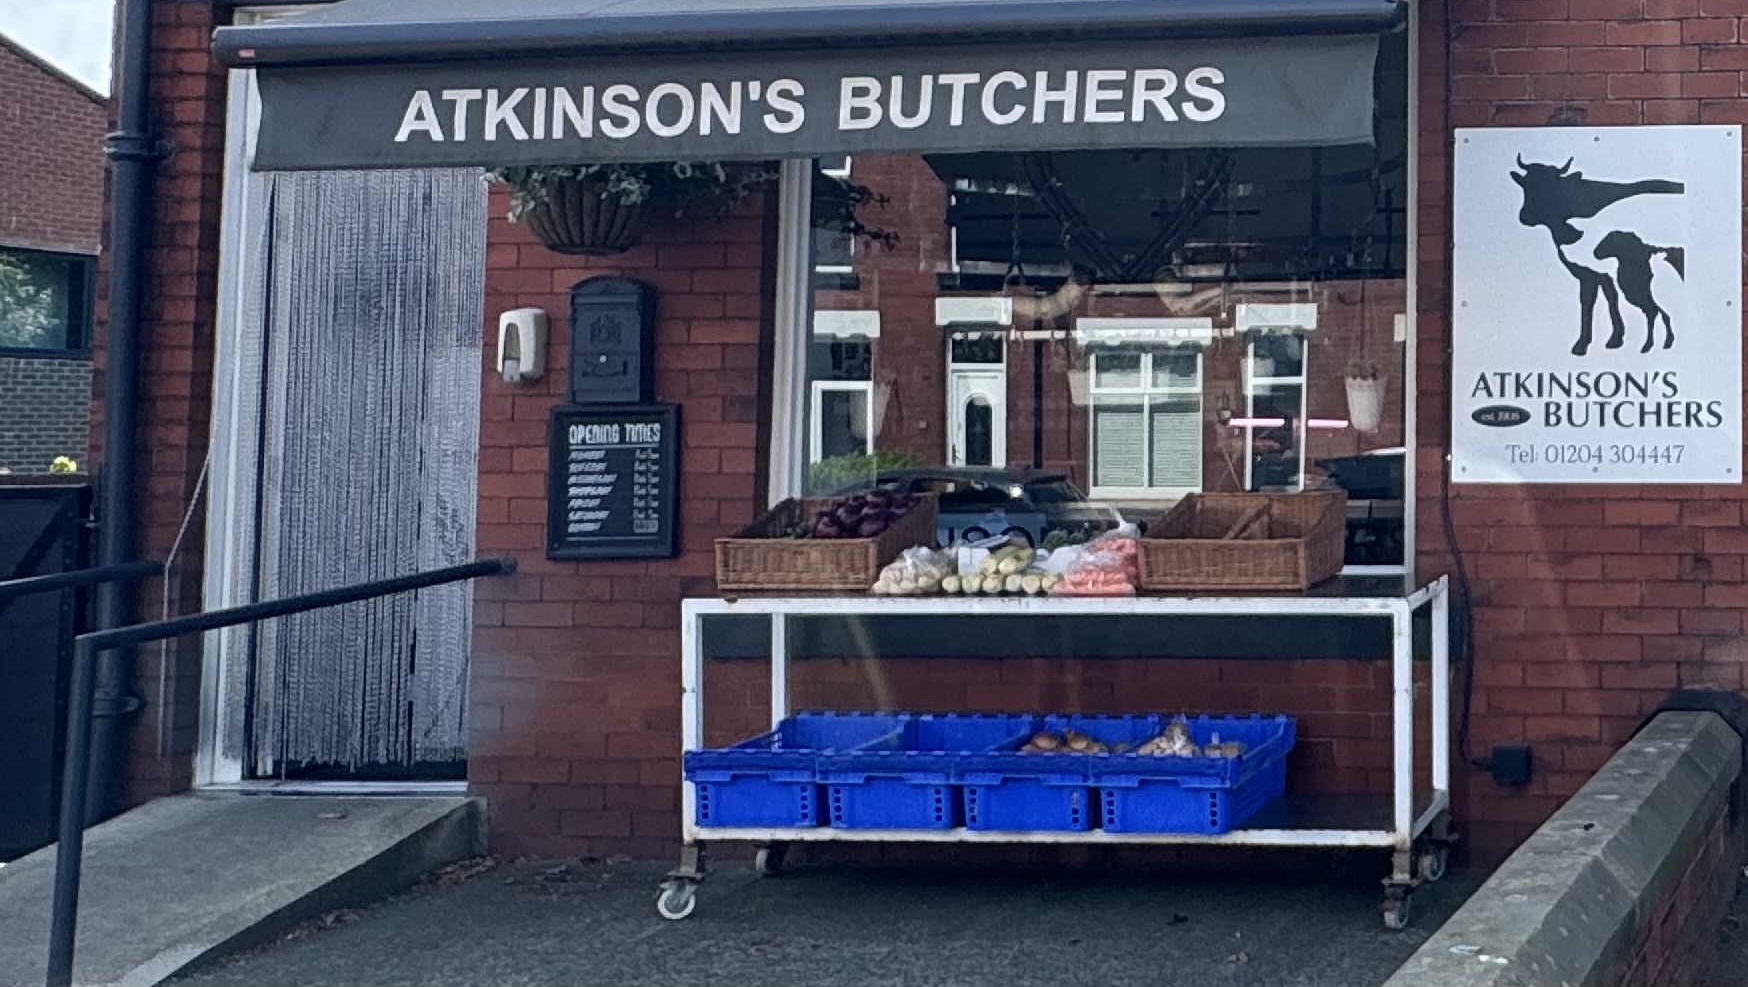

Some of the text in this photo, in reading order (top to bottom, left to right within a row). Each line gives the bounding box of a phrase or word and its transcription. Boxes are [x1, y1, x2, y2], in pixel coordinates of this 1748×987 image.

[394, 66, 1226, 142] ATKINSON'S BUTCHERS
[1471, 370, 1679, 399] ATKINSON'S
[1543, 400, 1723, 428] BUTCHERS
[624, 422, 661, 443] TIMES
[1505, 444, 1685, 464] Tel: 01204 304447
